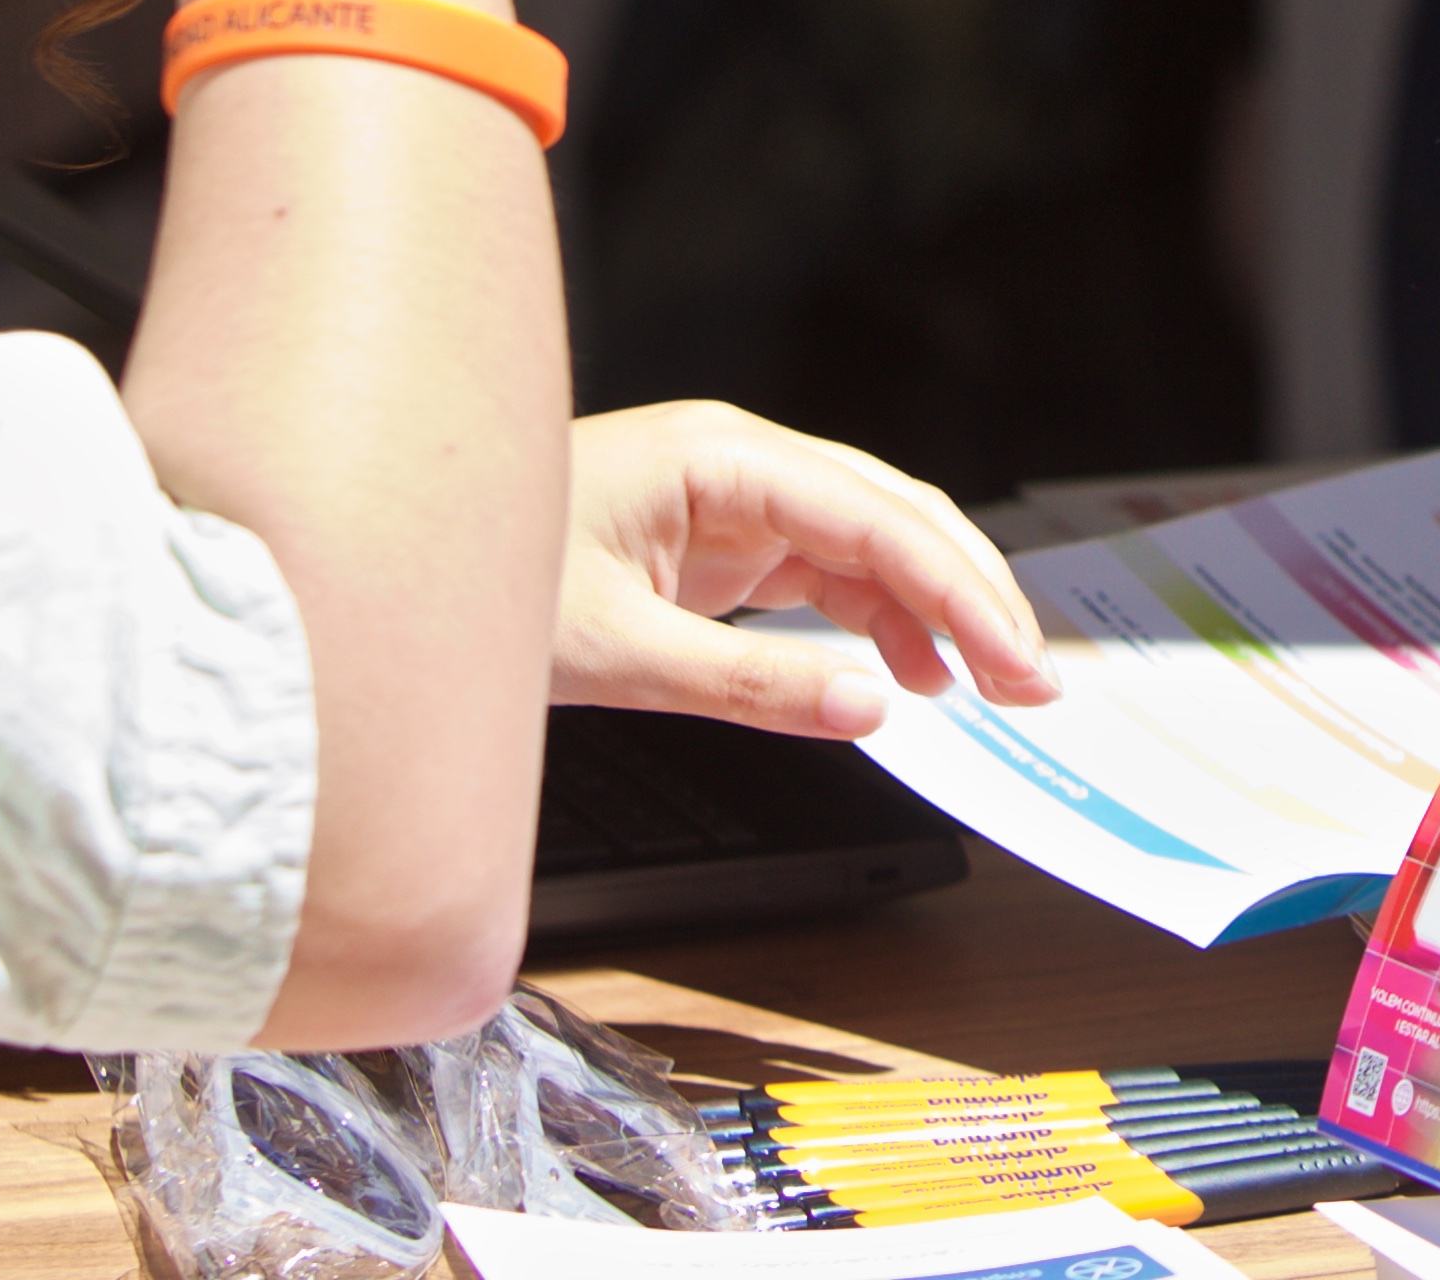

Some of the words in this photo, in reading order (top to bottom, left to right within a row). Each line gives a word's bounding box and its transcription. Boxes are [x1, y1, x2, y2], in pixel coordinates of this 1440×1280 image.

[224, 0, 376, 35] ALICANTE
[1371, 986, 1403, 1010] VOLEM
[1399, 1022, 1430, 1045] ESTAR
